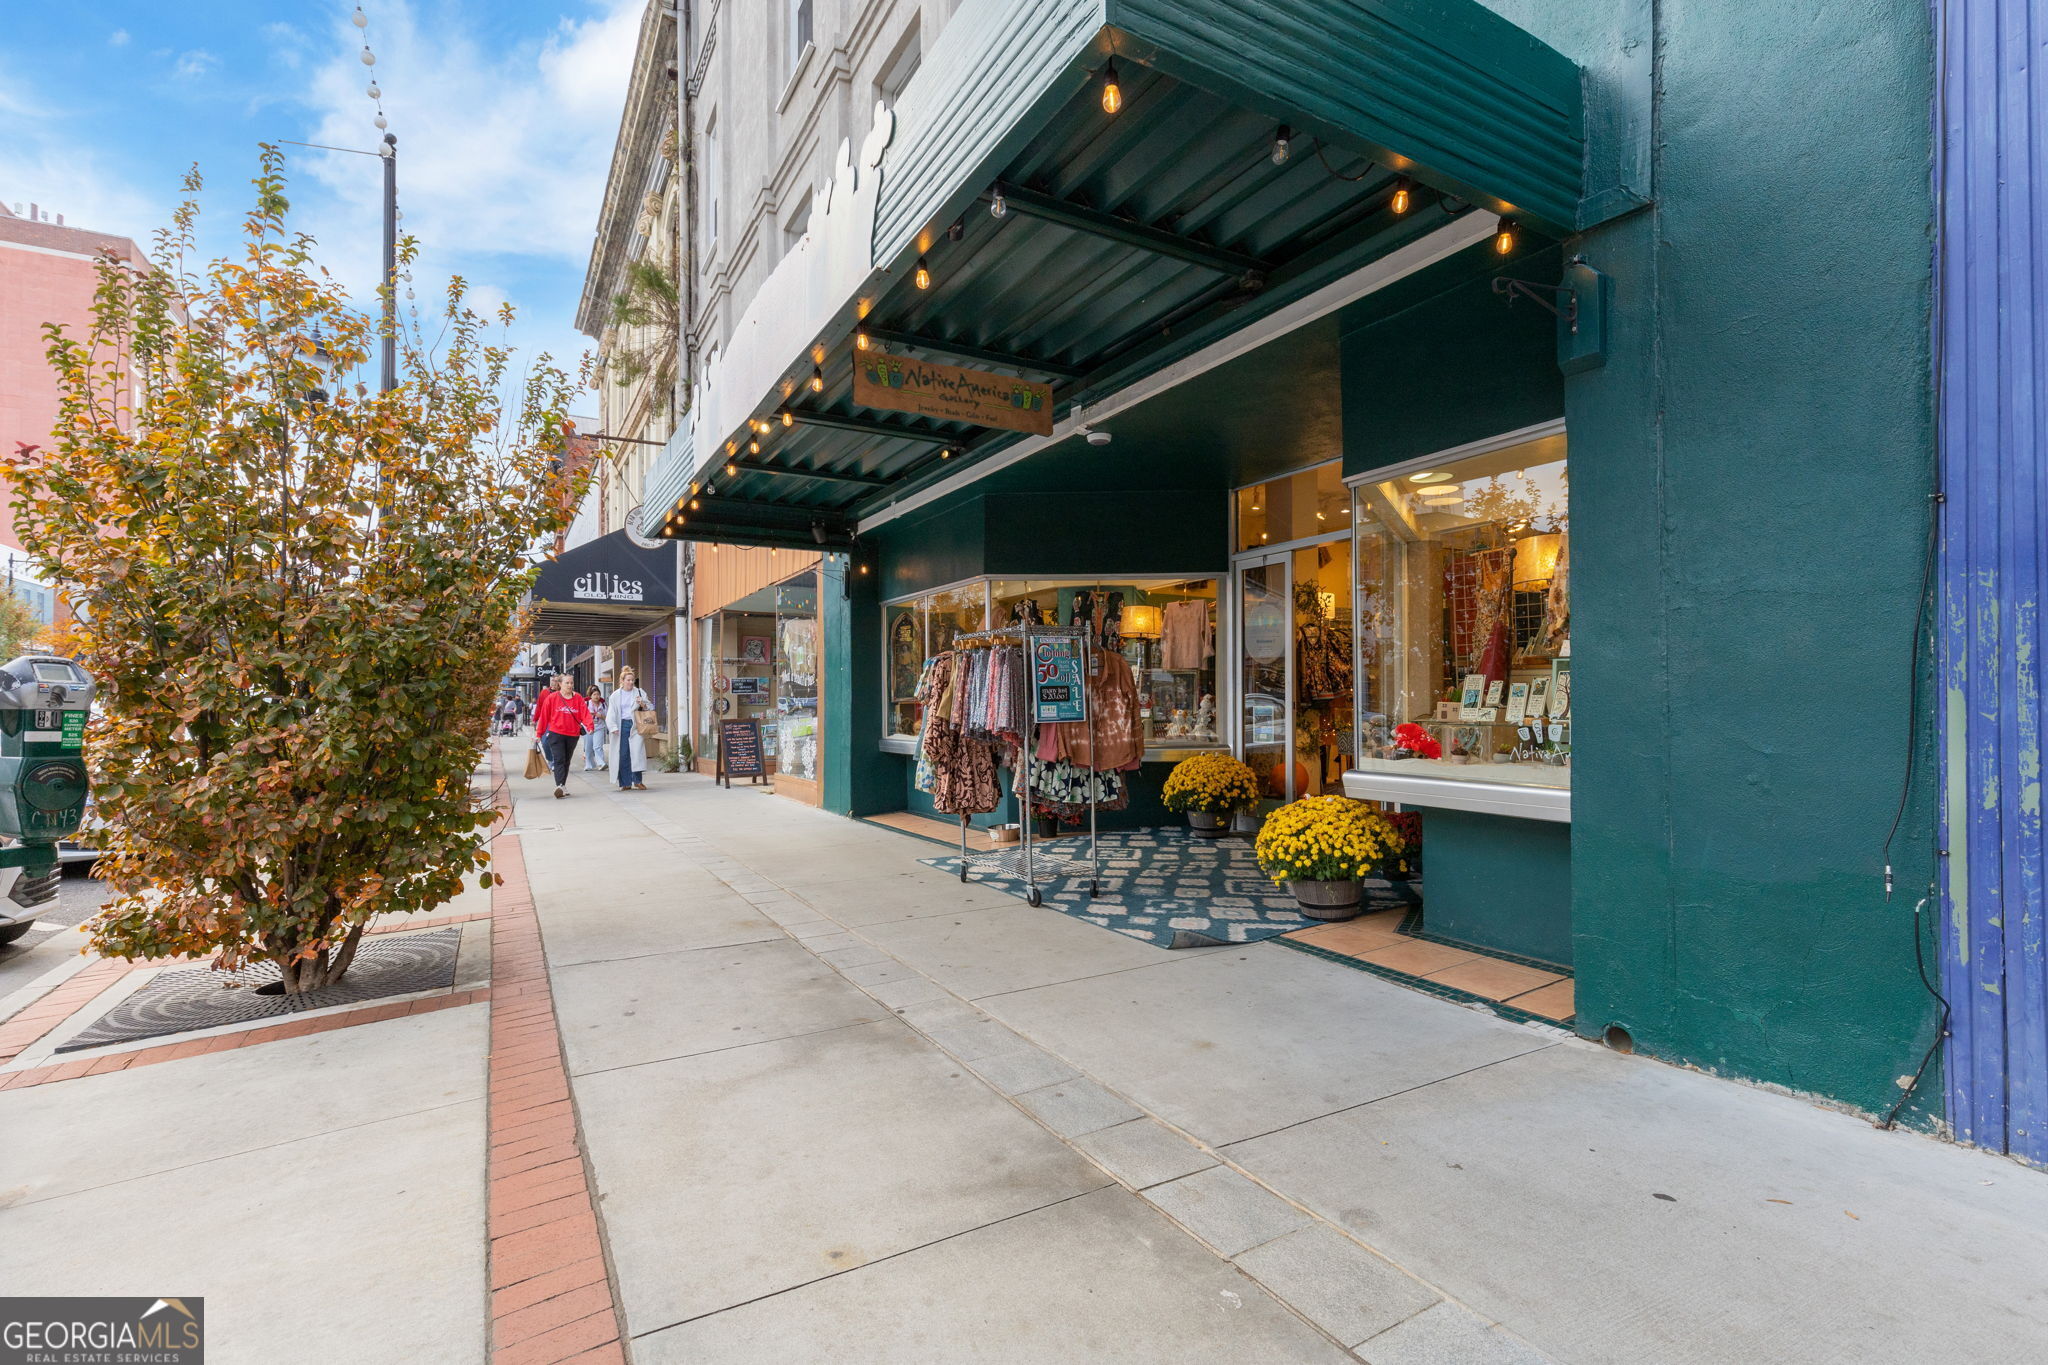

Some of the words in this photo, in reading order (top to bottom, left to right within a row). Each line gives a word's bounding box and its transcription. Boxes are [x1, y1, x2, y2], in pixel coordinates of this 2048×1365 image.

[573, 571, 643, 595] cillies
[1036, 643, 1071, 664] Clothing
[1509, 742, 1551, 763] Native
